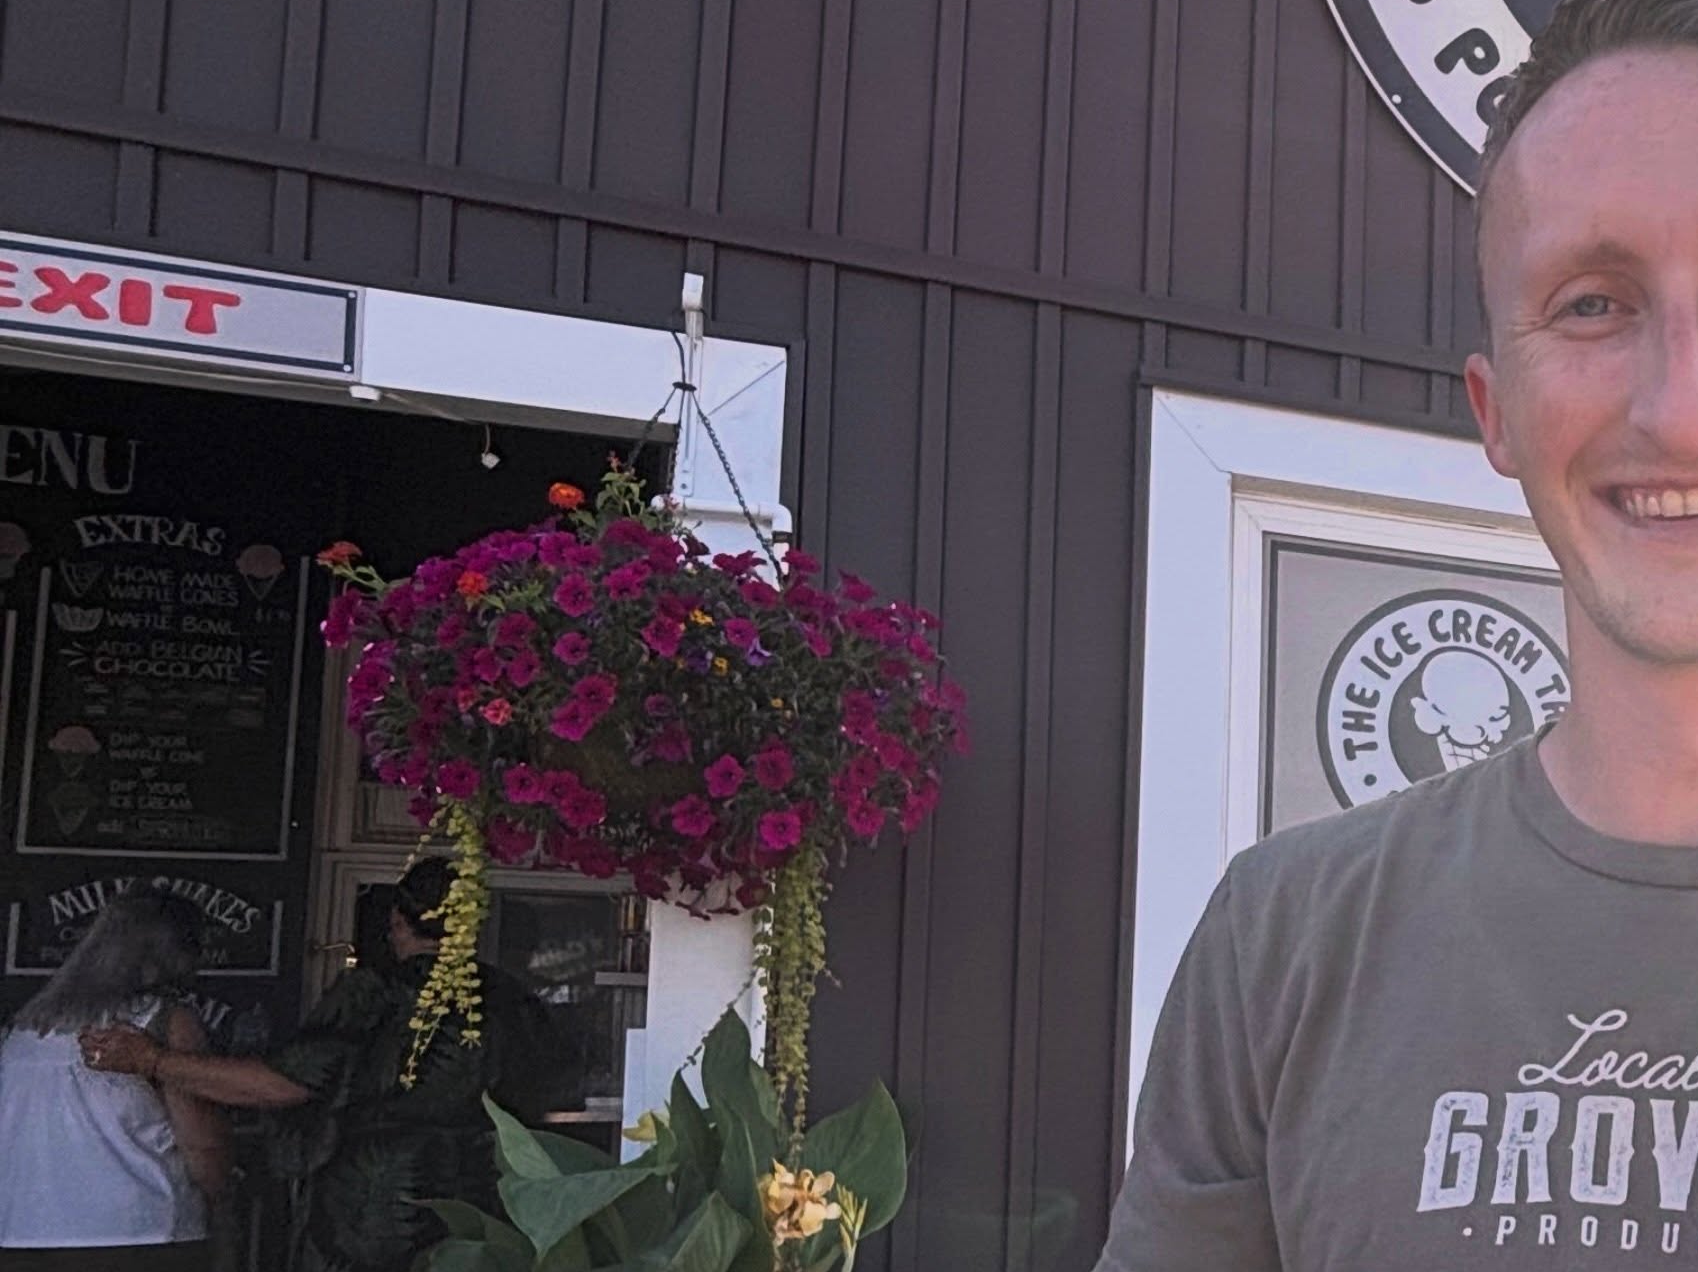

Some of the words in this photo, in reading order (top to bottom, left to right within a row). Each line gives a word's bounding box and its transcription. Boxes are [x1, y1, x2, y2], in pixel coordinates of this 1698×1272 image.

[74, 514, 227, 556] EXTRAS
[113, 565, 175, 584] HOME
[180, 571, 235, 589] MADE
[107, 583, 174, 603] WAFFLE
[180, 588, 239, 607] CONES
[106, 609, 172, 631] WAFFLE
[182, 616, 240, 636] BOWL
[97, 640, 142, 659] ADD
[151, 640, 242, 666] BELGIAN
[94, 656, 241, 680] CHOCOLATE
[1342, 683, 1380, 761] THE
[1361, 621, 1422, 680] ICE
[1428, 609, 1542, 674] CREAM
